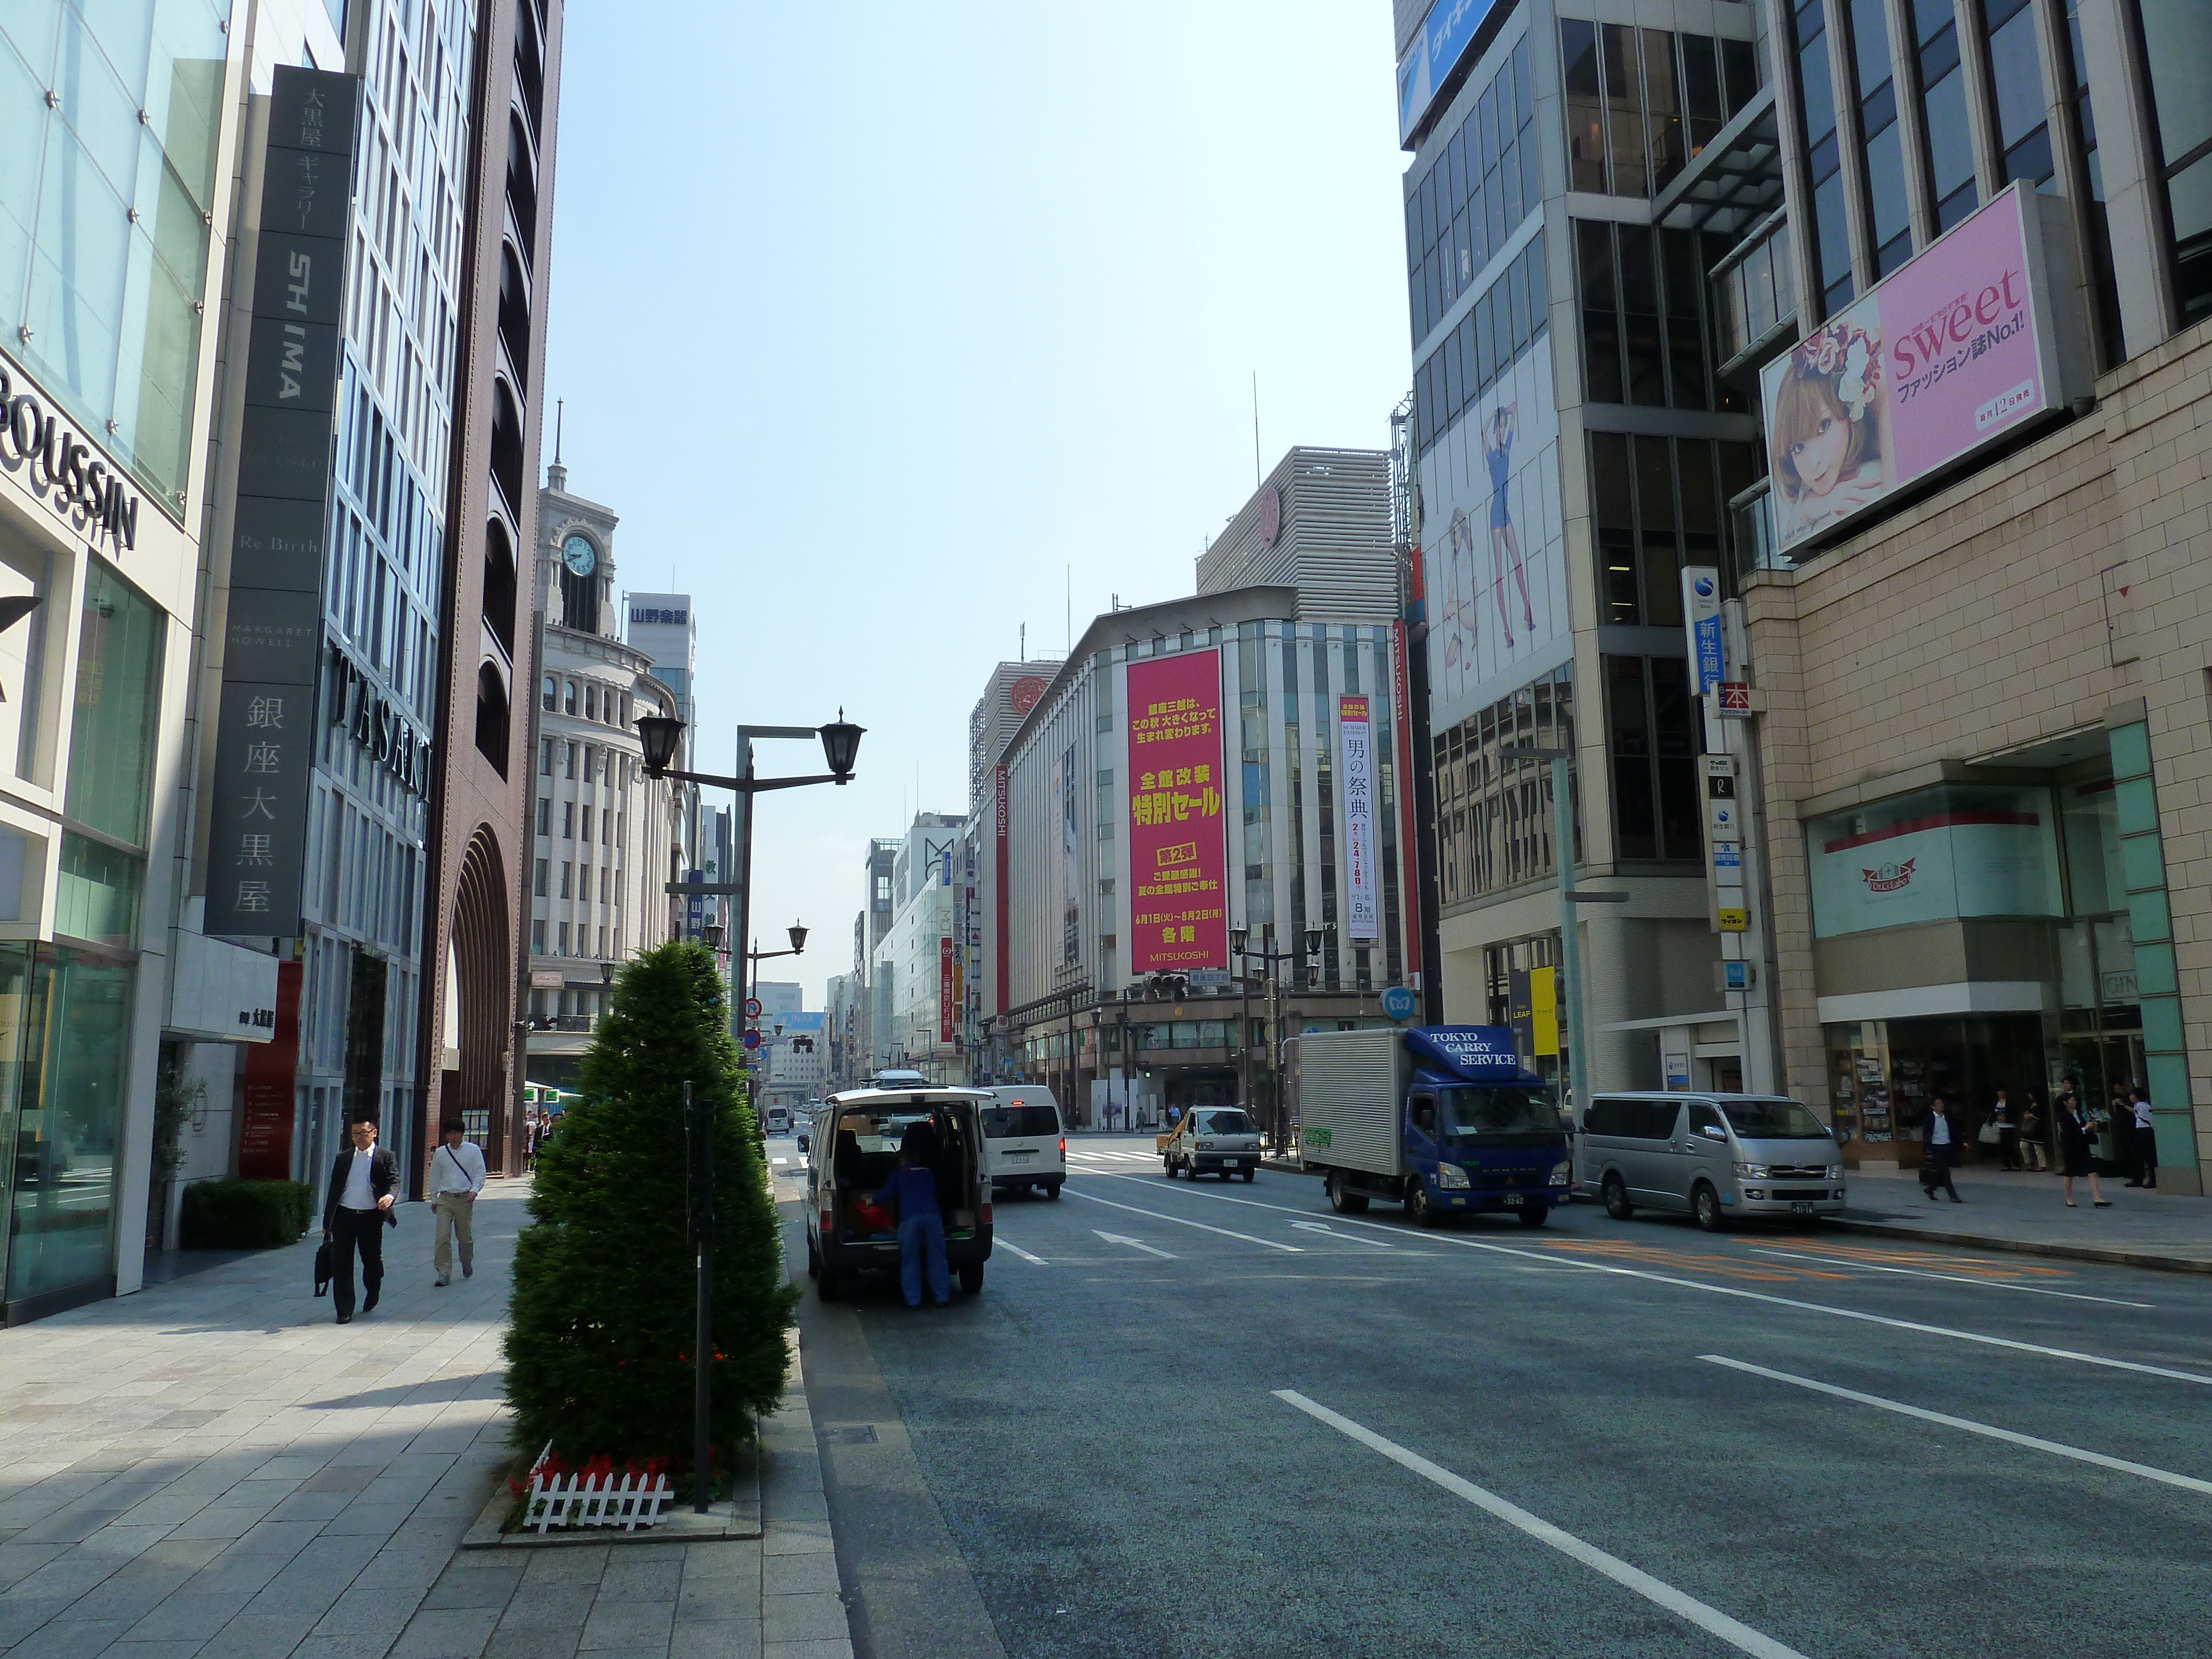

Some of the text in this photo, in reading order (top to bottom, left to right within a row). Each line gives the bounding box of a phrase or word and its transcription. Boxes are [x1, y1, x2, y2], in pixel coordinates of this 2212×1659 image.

[298, 88, 325, 229] 大黒屋 ギャラリー
[279, 249, 311, 399] SHIMA
[1894, 268, 2021, 380] sweet
[1979, 388, 2030, 422] 毎月12日発売
[240, 534, 318, 553] Re Birth
[631, 608, 687, 625] 山野楽器
[232, 624, 314, 637] MARGARET
[231, 637, 292, 648] HOWELL
[1700, 621, 1719, 691] 新生銀行
[1394, 628, 1403, 721] MITSUKOSHI
[1148, 698, 1201, 716] 銀座三越は、
[327, 641, 432, 804] TASAKI
[1132, 707, 1216, 731] この秋 大きくなって
[1136, 722, 1212, 744] 生まれ変わります。
[1140, 764, 1211, 790] 全館改装
[1347, 739, 1368, 819] 男の祭典
[236, 695, 284, 913] 銀座大黒屋
[998, 770, 1006, 836] MITSUKOSHI
[1132, 786, 1221, 826] 特別セール
[1159, 843, 1194, 864] 第2弾
[1138, 879, 1218, 897] 夏の全館特別ご奉仕
[1162, 925, 1196, 944] 各階
[1150, 950, 1209, 962] MITSUKOSHI
[1513, 1010, 1532, 1019] LEAF
[1430, 1032, 1478, 1043] TOKYO
[1445, 1043, 1493, 1052] CARRY
[1460, 1054, 1516, 1066] SERVICE
